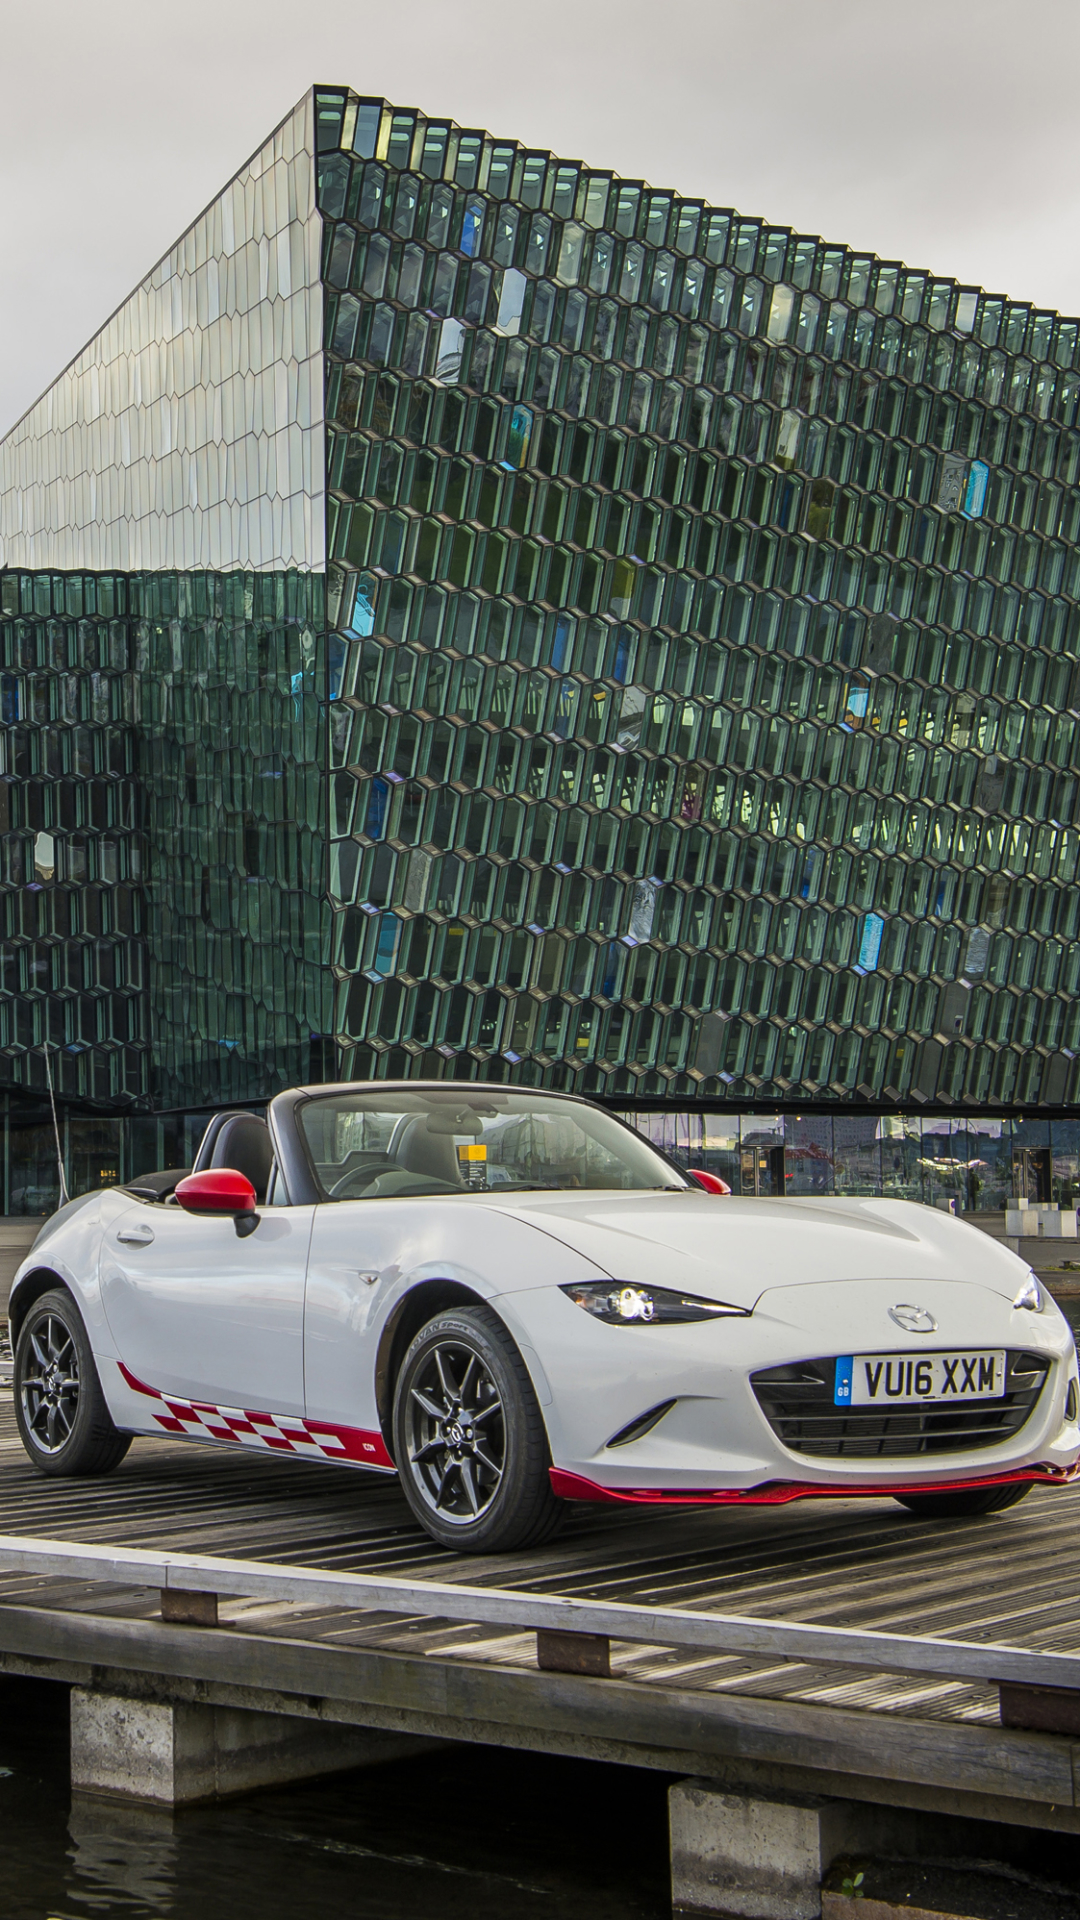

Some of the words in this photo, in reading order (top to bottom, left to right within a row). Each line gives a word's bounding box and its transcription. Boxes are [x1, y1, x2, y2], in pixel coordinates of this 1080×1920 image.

[864, 1360, 933, 1397] VU16
[941, 1356, 995, 1394] XXM
[837, 1387, 849, 1397] GB
